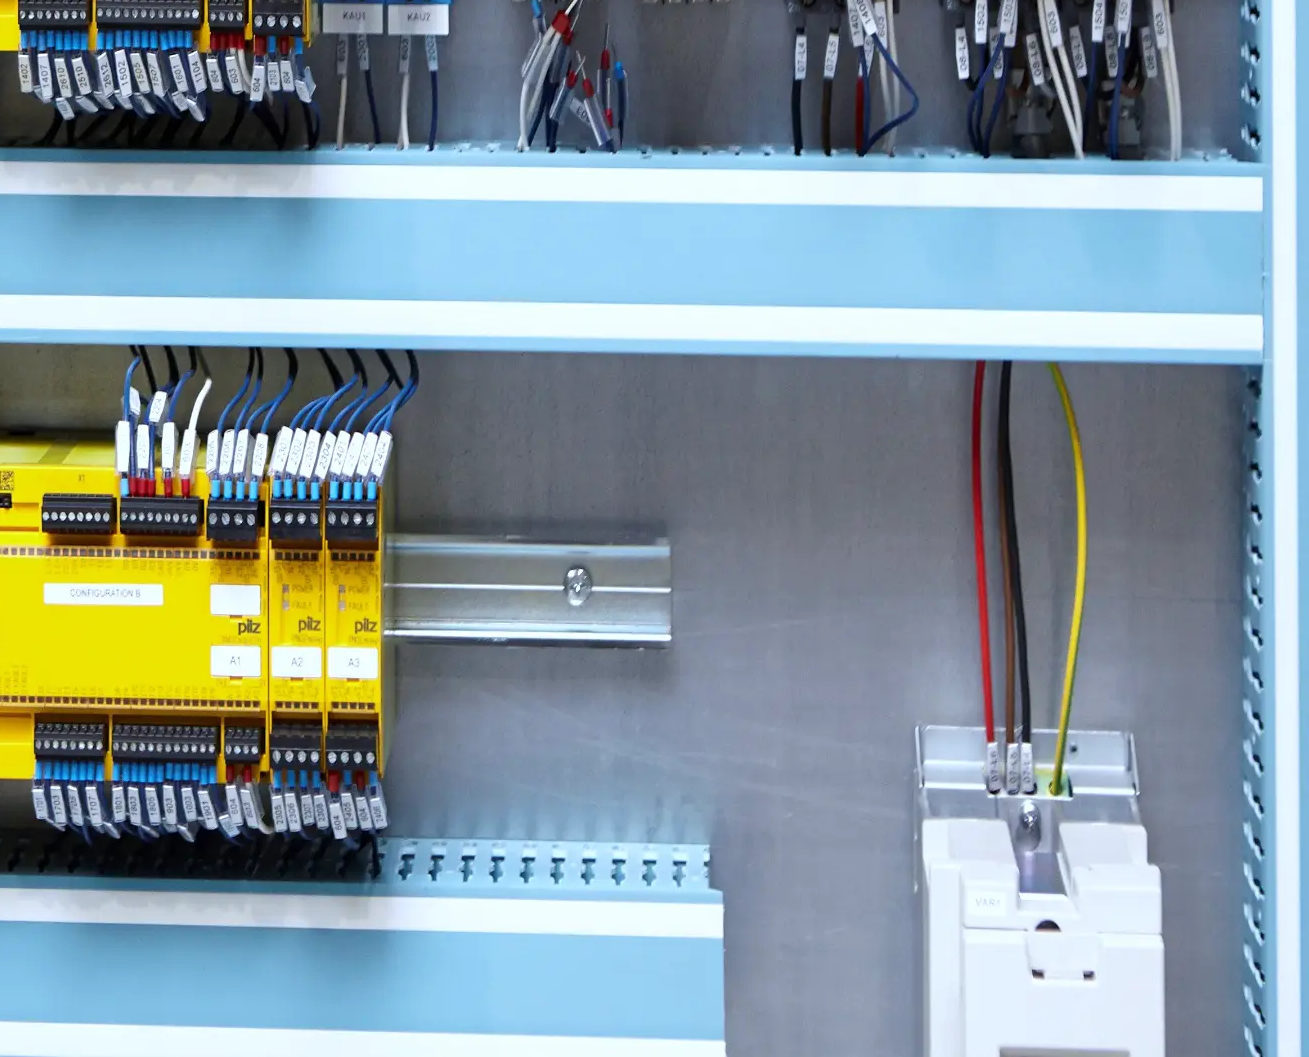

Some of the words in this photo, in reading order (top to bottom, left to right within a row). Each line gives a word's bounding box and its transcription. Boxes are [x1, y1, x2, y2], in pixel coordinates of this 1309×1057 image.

[342, 11, 366, 21] KAU1
[407, 12, 431, 22] KAU2
[977, 3, 985, 32] 1502
[1047, 10, 1058, 34] 603
[1094, 2, 1103, 30] 1504
[1155, 12, 1165, 35] 603
[797, 42, 805, 73] 07-L4
[826, 41, 836, 72] 07-L5
[21, 63, 29, 84] 1402
[40, 64, 49, 88] 1407
[57, 67, 69, 90] 2610
[75, 66, 87, 88] 2510
[100, 62, 111, 88] 2612
[118, 60, 129, 86] 1502
[134, 62, 145, 84] 1505
[173, 64, 184, 84] 1601
[192, 60, 203, 82] 1104
[229, 68, 238, 84] 603
[269, 69, 278, 86] 2103
[252, 77, 261, 93] 604
[319, 442, 331, 470] 2304
[70, 588, 134, 598] CONFIGURATION
[136, 589, 141, 598] B
[238, 618, 260, 635] pilz
[298, 616, 321, 633] pilz
[354, 618, 377, 634] pilz
[230, 656, 241, 666] A1
[291, 658, 303, 667] A2
[348, 658, 360, 667] A3
[35, 797, 43, 813] 1701
[52, 796, 62, 815] 1703
[88, 796, 97, 816] 1707
[114, 796, 122, 814] 1801
[129, 796, 138, 816] 1803
[274, 804, 283, 824] 2305
[287, 802, 297, 824] 2306
[344, 802, 354, 822] 2405
[359, 808, 368, 822] 604
[333, 814, 342, 831] 604
[975, 897, 1001, 908] VAR1
